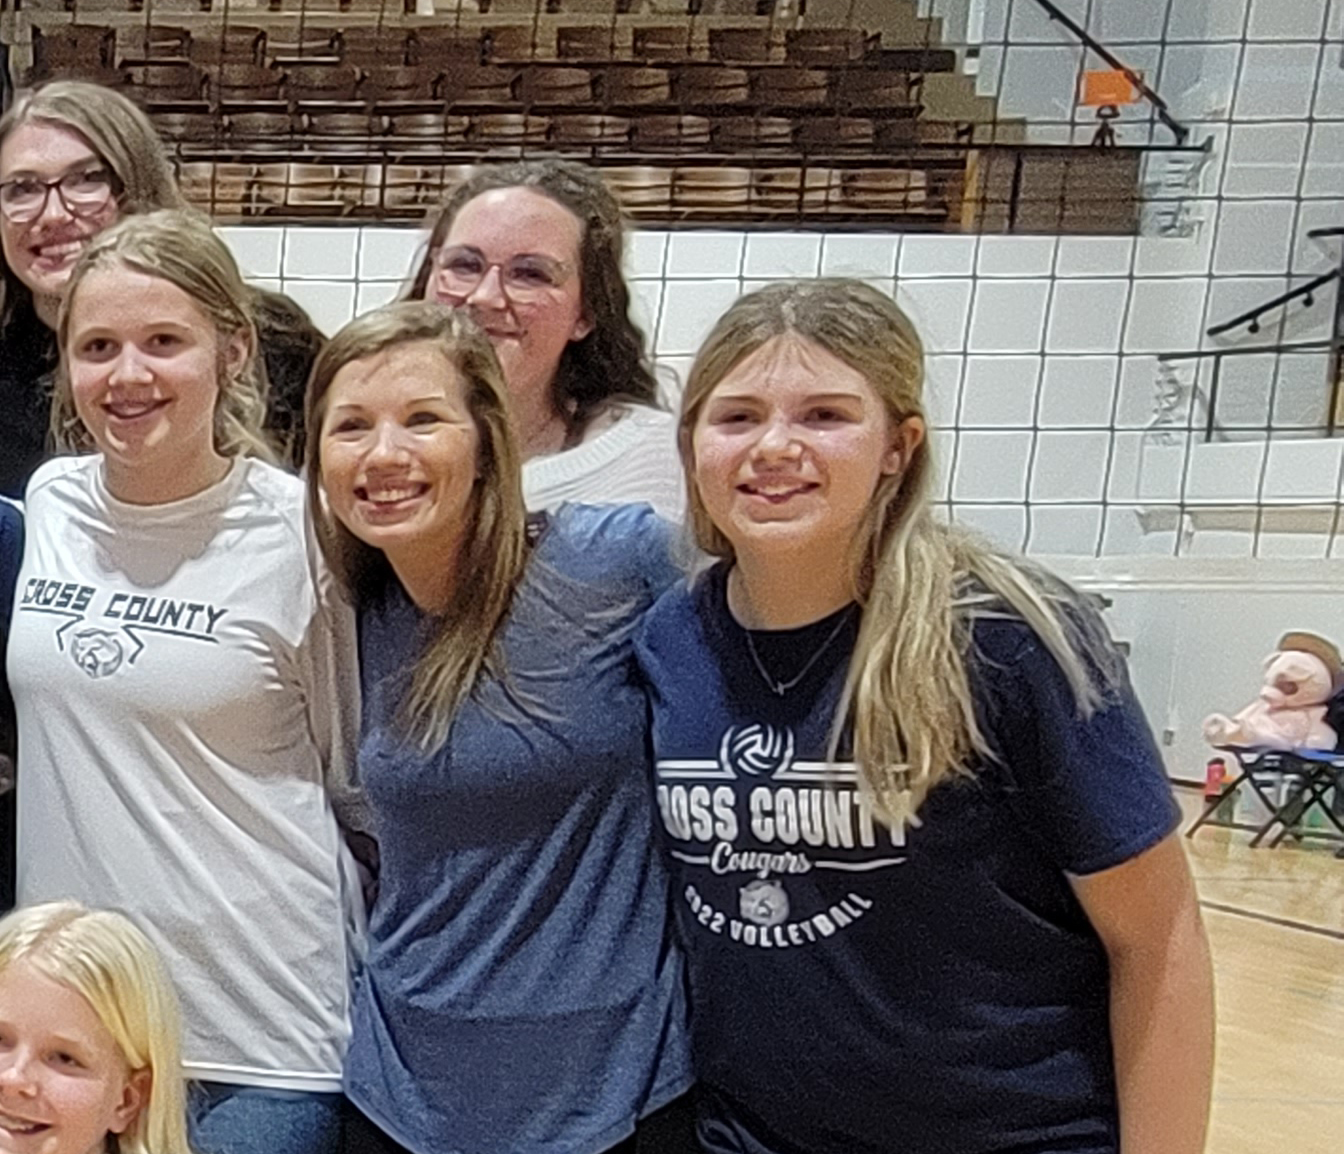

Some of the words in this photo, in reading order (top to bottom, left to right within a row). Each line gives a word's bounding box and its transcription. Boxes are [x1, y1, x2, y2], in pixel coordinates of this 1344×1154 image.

[21, 577, 96, 612] CROSS
[104, 592, 229, 634] COUNTY
[657, 784, 739, 841] OSS
[711, 841, 812, 878] Cougars
[730, 892, 873, 947] VOLLEYBALL
